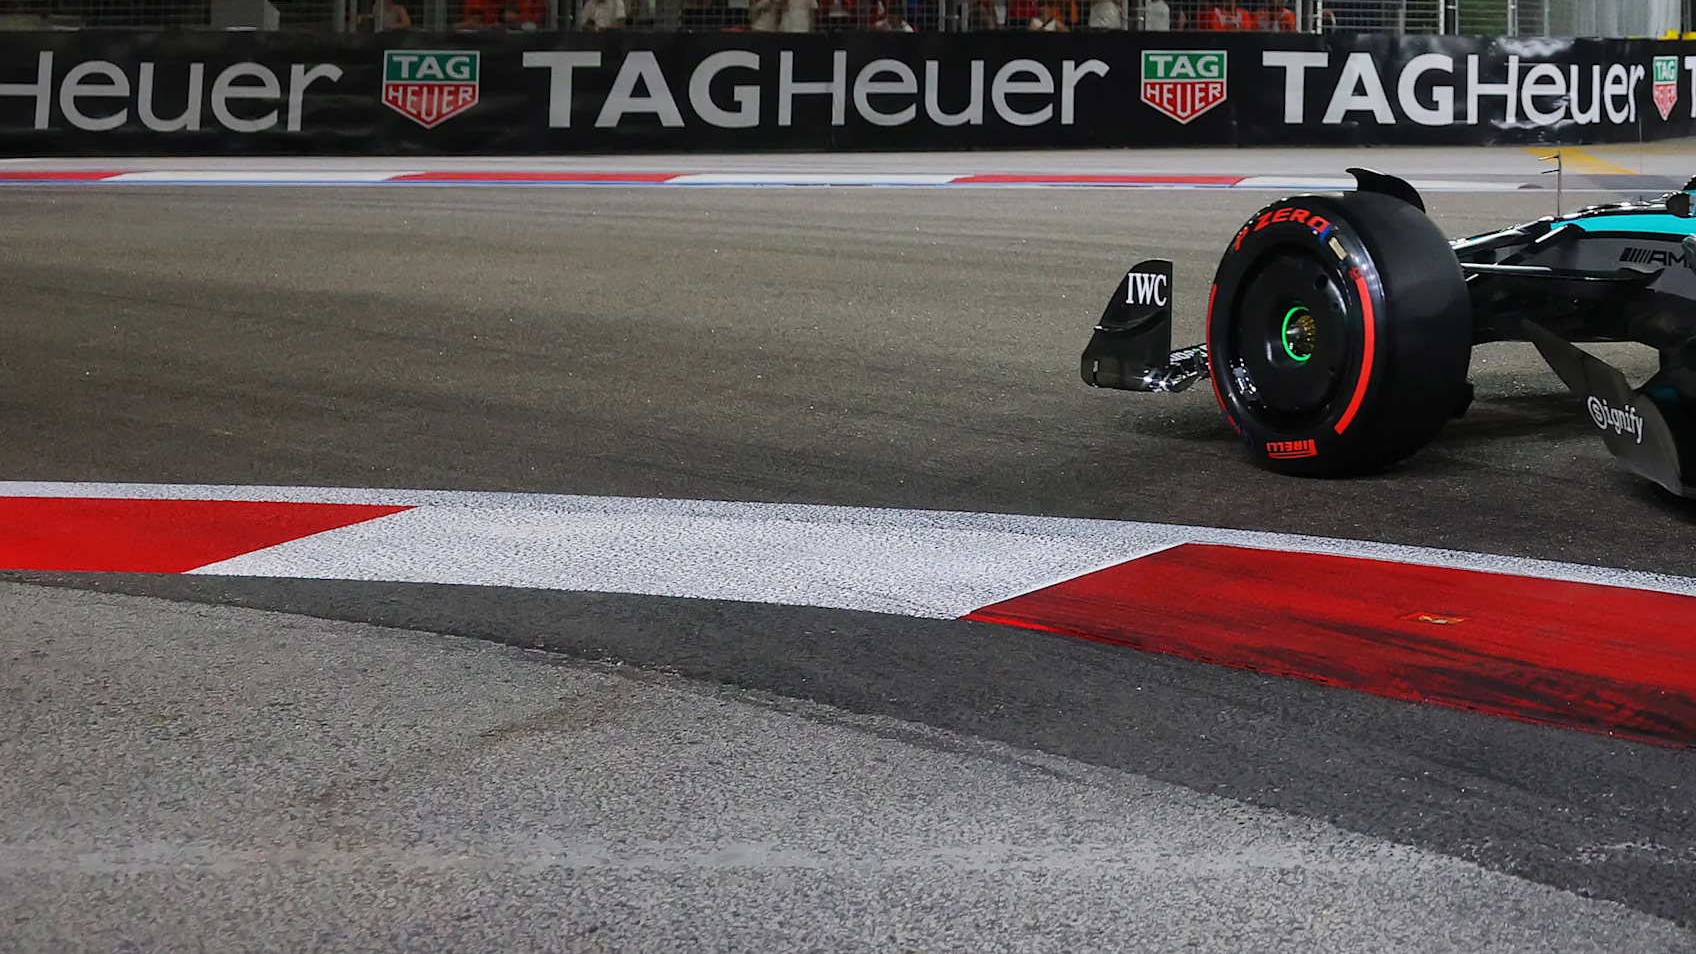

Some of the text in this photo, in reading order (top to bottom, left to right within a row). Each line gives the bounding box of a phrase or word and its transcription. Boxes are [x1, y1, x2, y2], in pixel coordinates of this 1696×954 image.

[392, 55, 470, 79] TAG
[1148, 55, 1219, 78] TAG
[1655, 60, 1676, 80] TAG
[0, 50, 343, 133] Heuer
[387, 84, 474, 122] HEUER
[1145, 83, 1222, 117] HEUER
[1253, 206, 1332, 234] ZERO
[1125, 272, 1168, 307] IWC
[1265, 438, 1320, 461] PIRELLI
